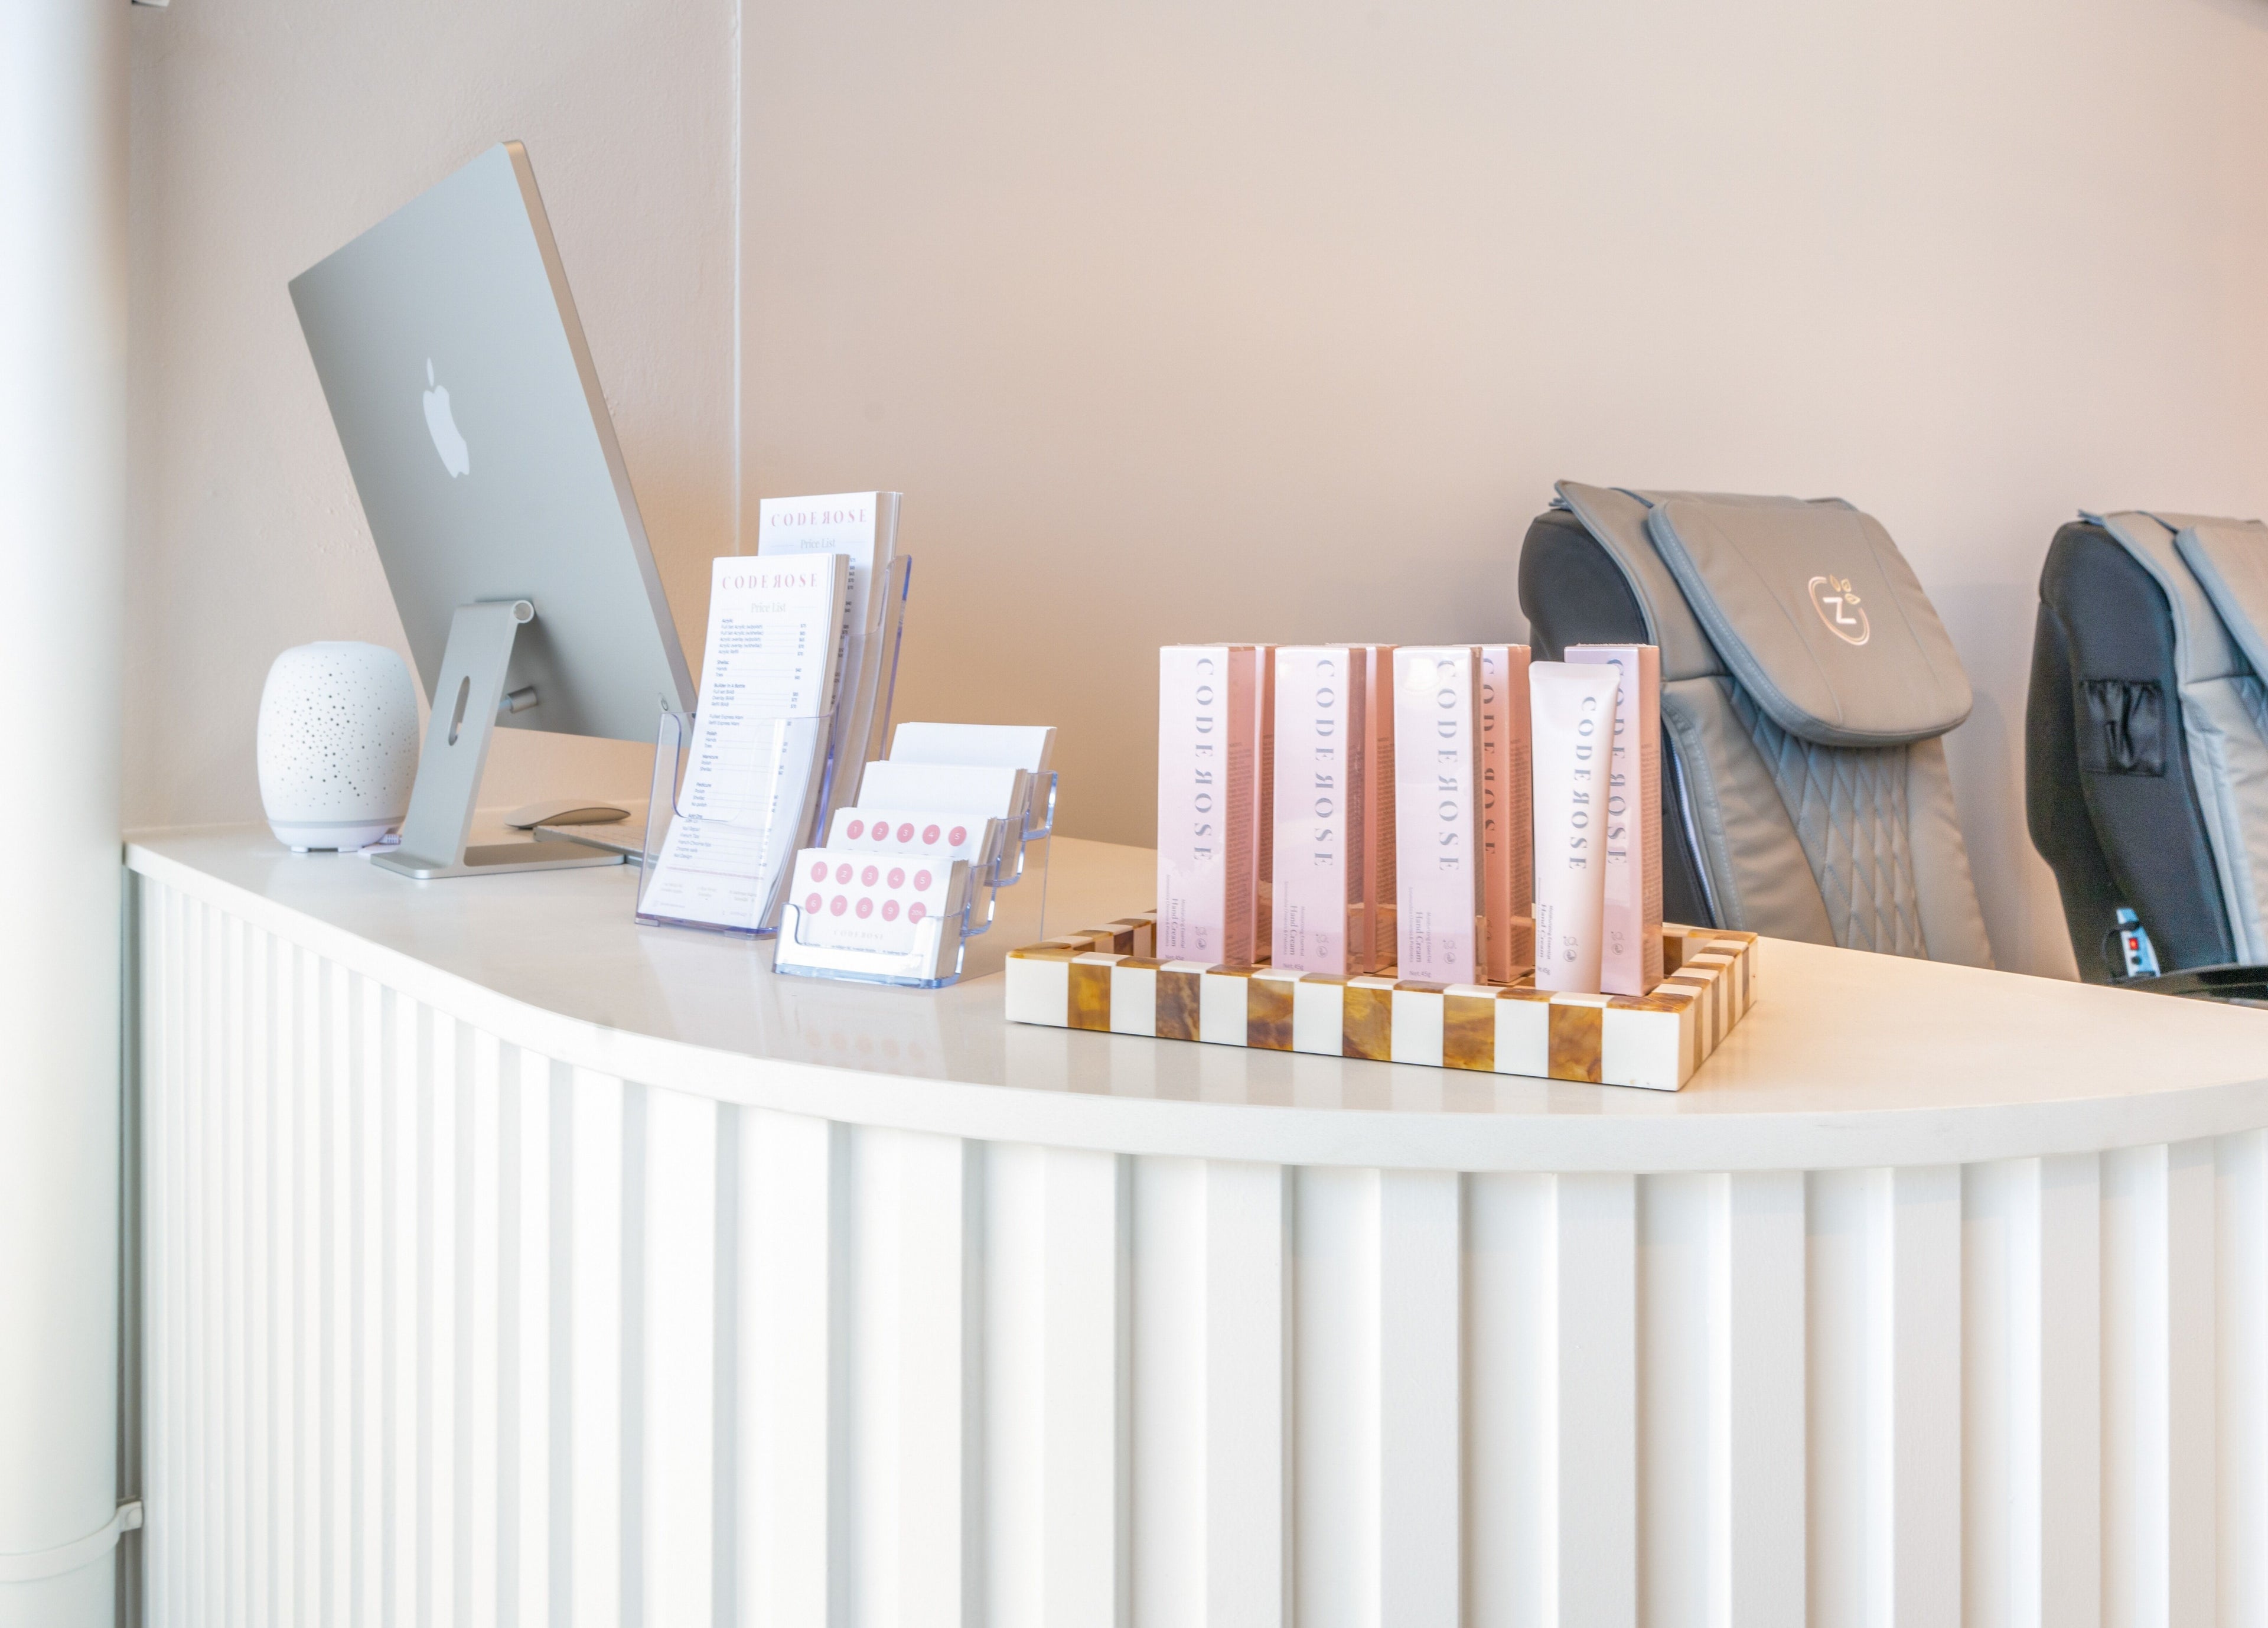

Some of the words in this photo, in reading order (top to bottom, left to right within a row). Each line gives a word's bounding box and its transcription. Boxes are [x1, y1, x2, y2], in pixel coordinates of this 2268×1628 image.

[751, 603, 771, 613] Price
[773, 602, 786, 613] List
[801, 539, 819, 549] Price
[822, 538, 836, 549] List
[1194, 658, 1214, 861] CODEROSE
[1314, 659, 1335, 867] CODEROSE
[1436, 659, 1459, 871] CODEROSE
[1569, 696, 1597, 870] CODEROSE
